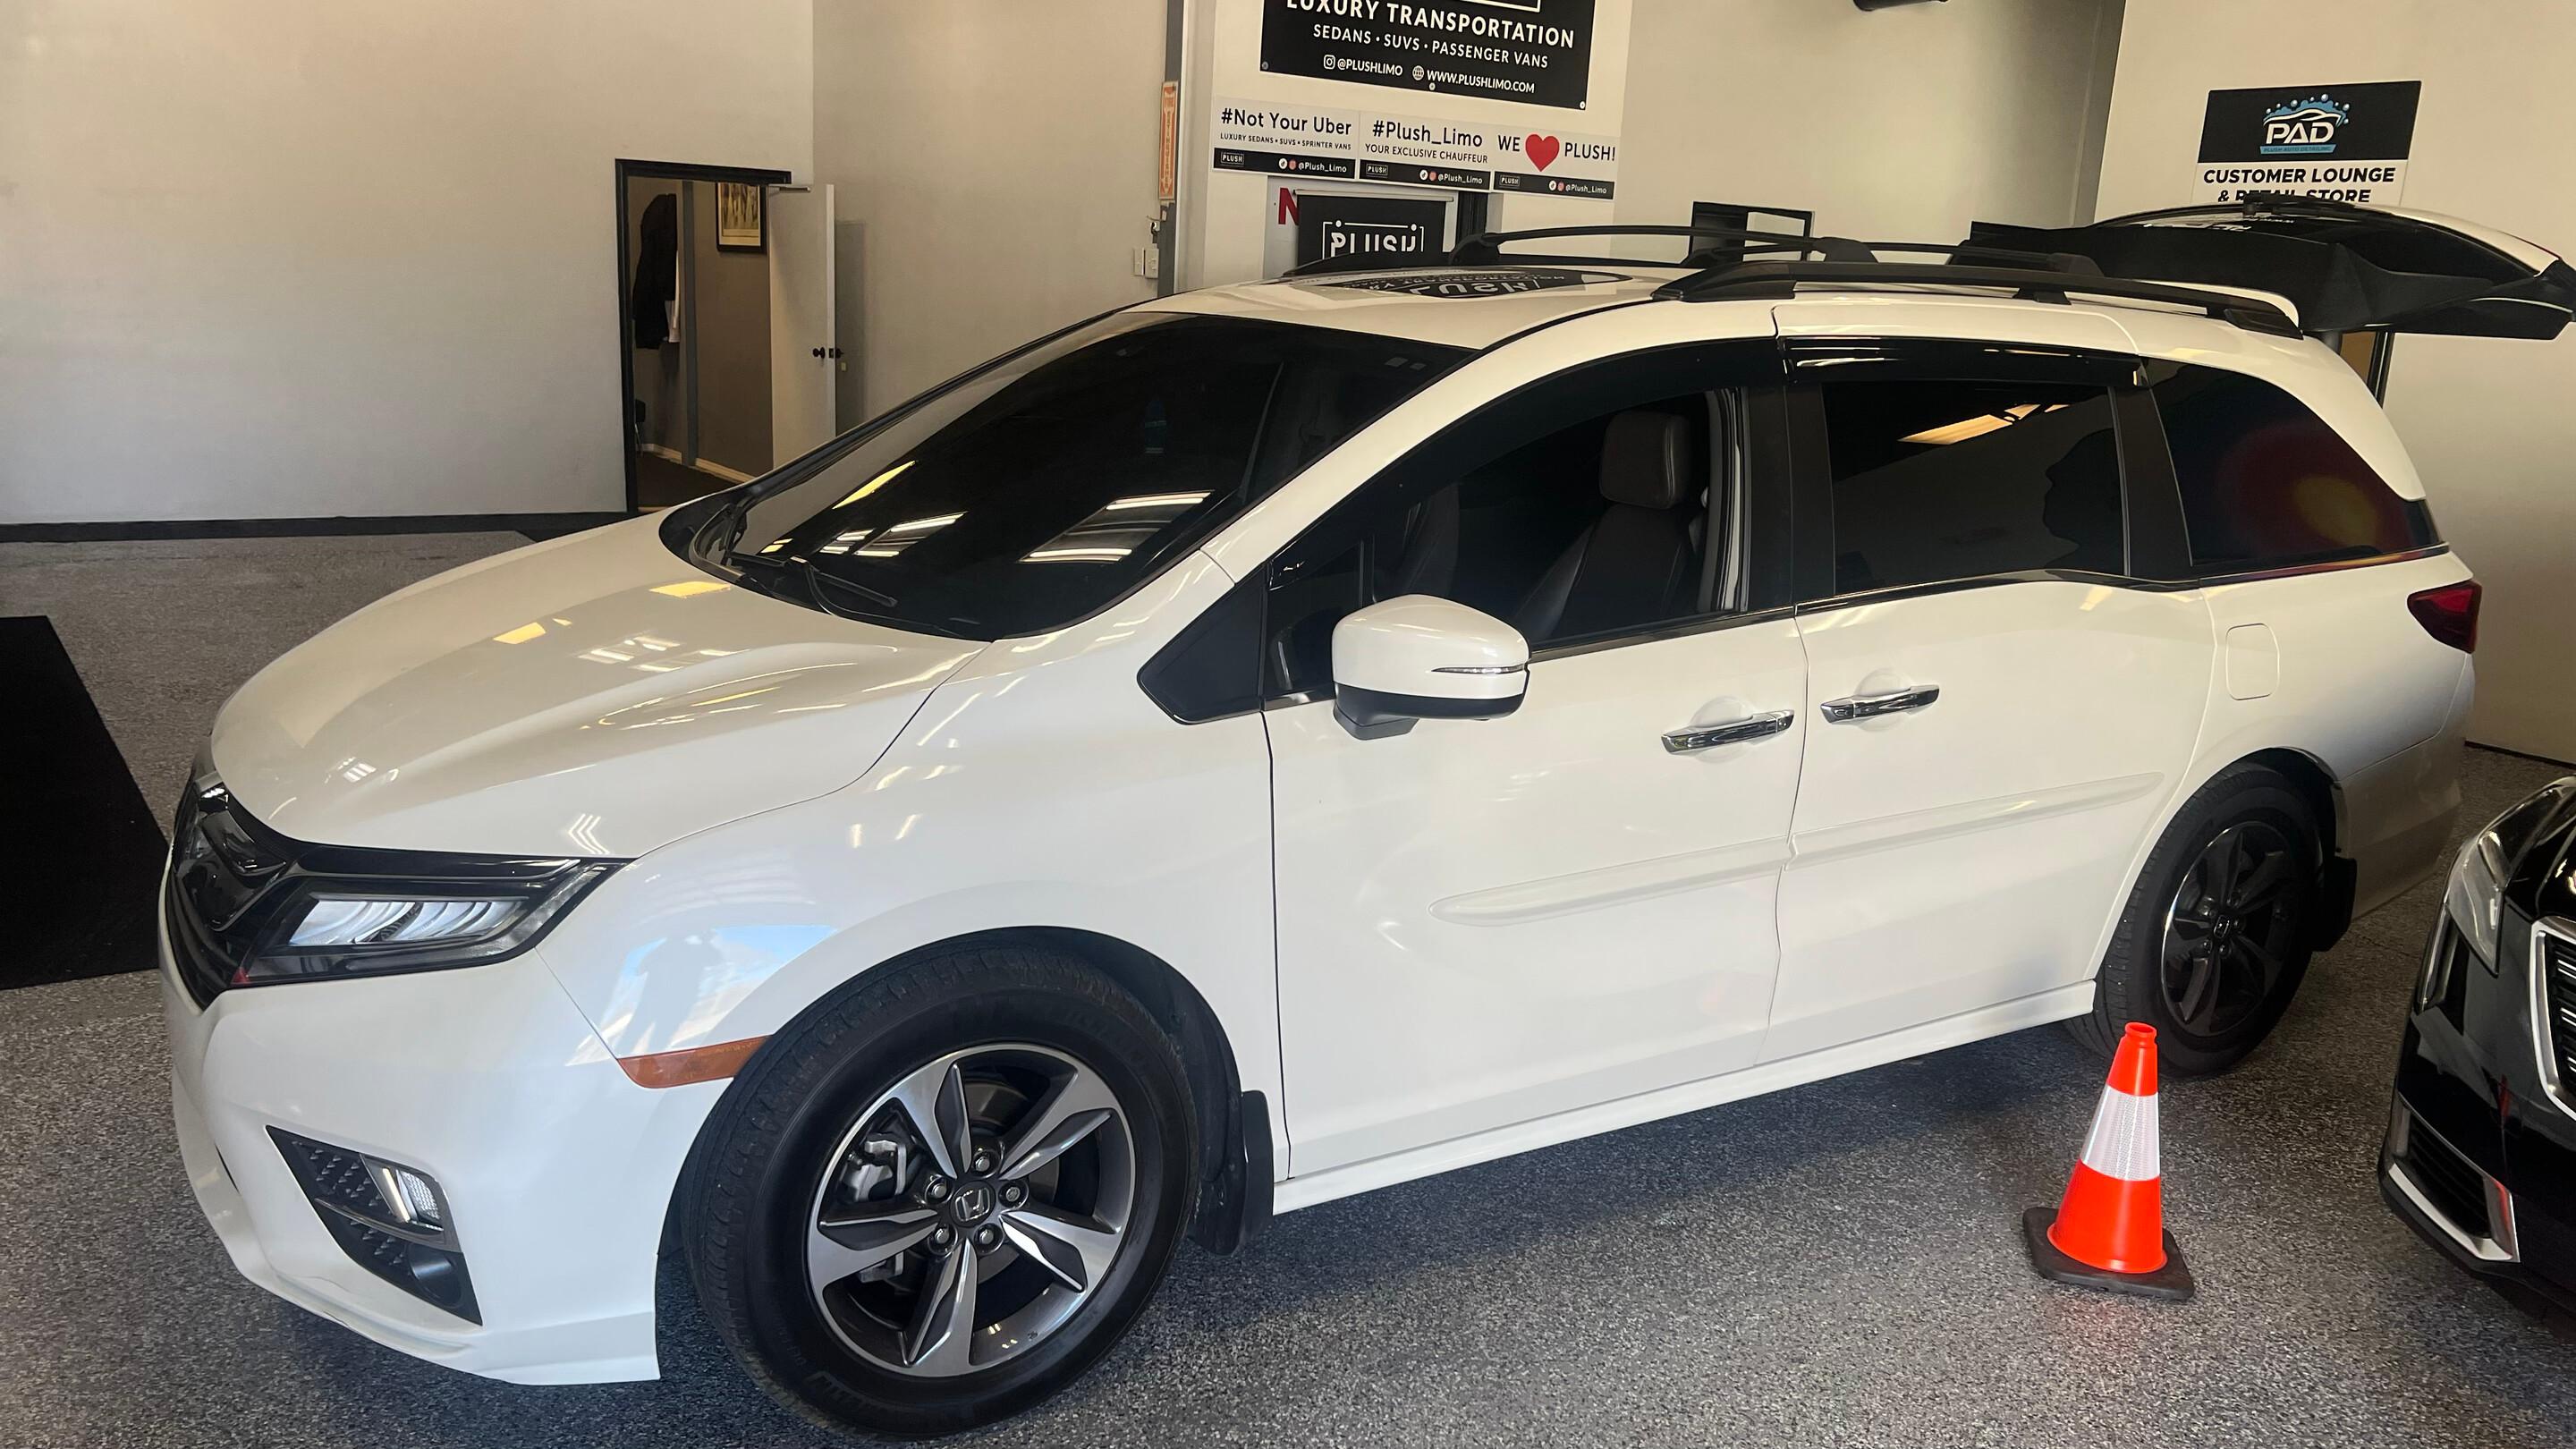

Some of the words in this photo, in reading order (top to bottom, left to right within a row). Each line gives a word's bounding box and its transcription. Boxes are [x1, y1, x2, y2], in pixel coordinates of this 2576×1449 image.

[1386, 3, 1574, 48] TRANSPORTATION
[1313, 23, 1371, 45] SEDANS
[1383, 33, 1420, 51] SUVS
[1431, 40, 1509, 64] PASSENGER
[1513, 51, 1548, 69] VANS
[1337, 58, 1403, 76] @PLUSHLIMO
[1427, 69, 1535, 93] WWW.PLUSHLIMO.COM
[1221, 107, 1264, 128] #Not
[1269, 112, 1308, 131] Your
[1313, 116, 1352, 135] Uber
[1220, 133, 1247, 141] LUXURY
[1248, 135, 1274, 144] SEDANS
[1279, 138, 1296, 146] SUVS
[1301, 140, 1333, 148] SPRINTER
[1372, 120, 1483, 147] #Plush_Limo
[2266, 122, 2334, 144] PAD
[1365, 143, 1390, 155] YOUR
[1392, 146, 1437, 159] EXCLUSIVE
[1439, 150, 1488, 164] CHAUFFEUR
[1497, 134, 1521, 152] WE
[1564, 141, 1616, 162] PLUSH!
[1222, 154, 1243, 163] PLUSH
[1298, 162, 1347, 173] @Plush_Limo
[1367, 165, 1387, 174] PLUSH
[1437, 173, 1483, 184] @Plush_Limo
[2203, 168, 2307, 183] CUSTOMER
[2311, 167, 2396, 183] LOUNGE
[1565, 183, 1607, 194] @Plush_Limo
